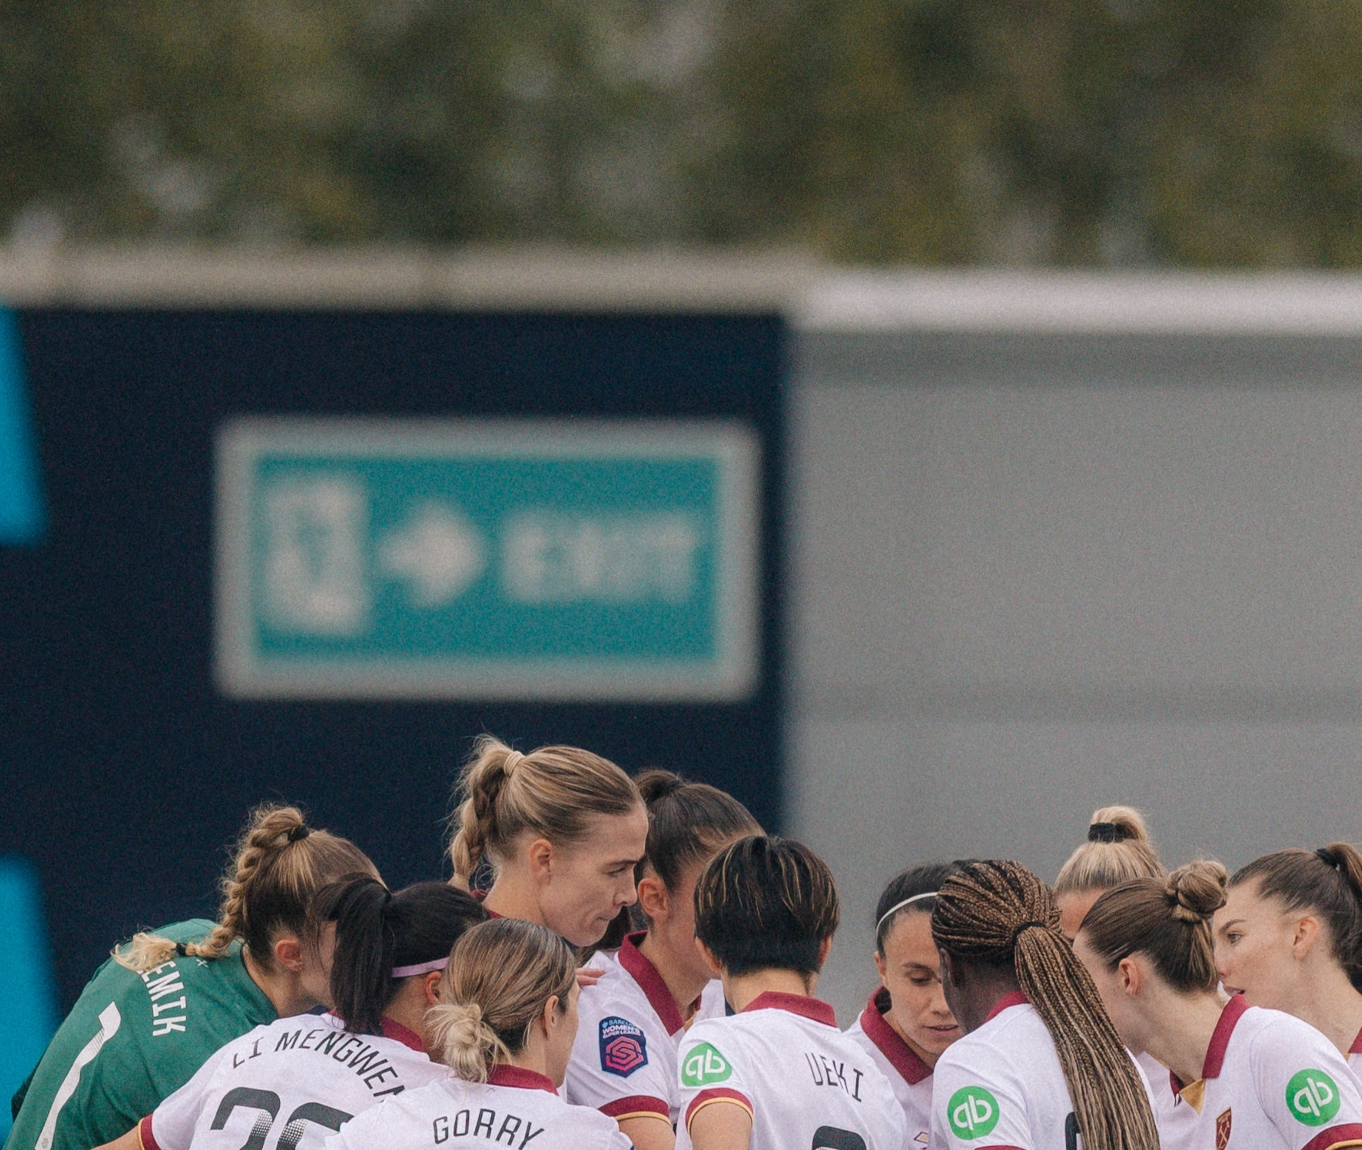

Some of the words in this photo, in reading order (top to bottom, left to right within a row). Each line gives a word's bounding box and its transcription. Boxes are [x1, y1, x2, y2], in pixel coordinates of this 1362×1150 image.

[501, 511, 698, 599] EXIT
[136, 958, 187, 1037] EMIK
[232, 1036, 265, 1070] LI
[804, 1052, 864, 1103] UEKI
[432, 1108, 545, 1150] GORRY
